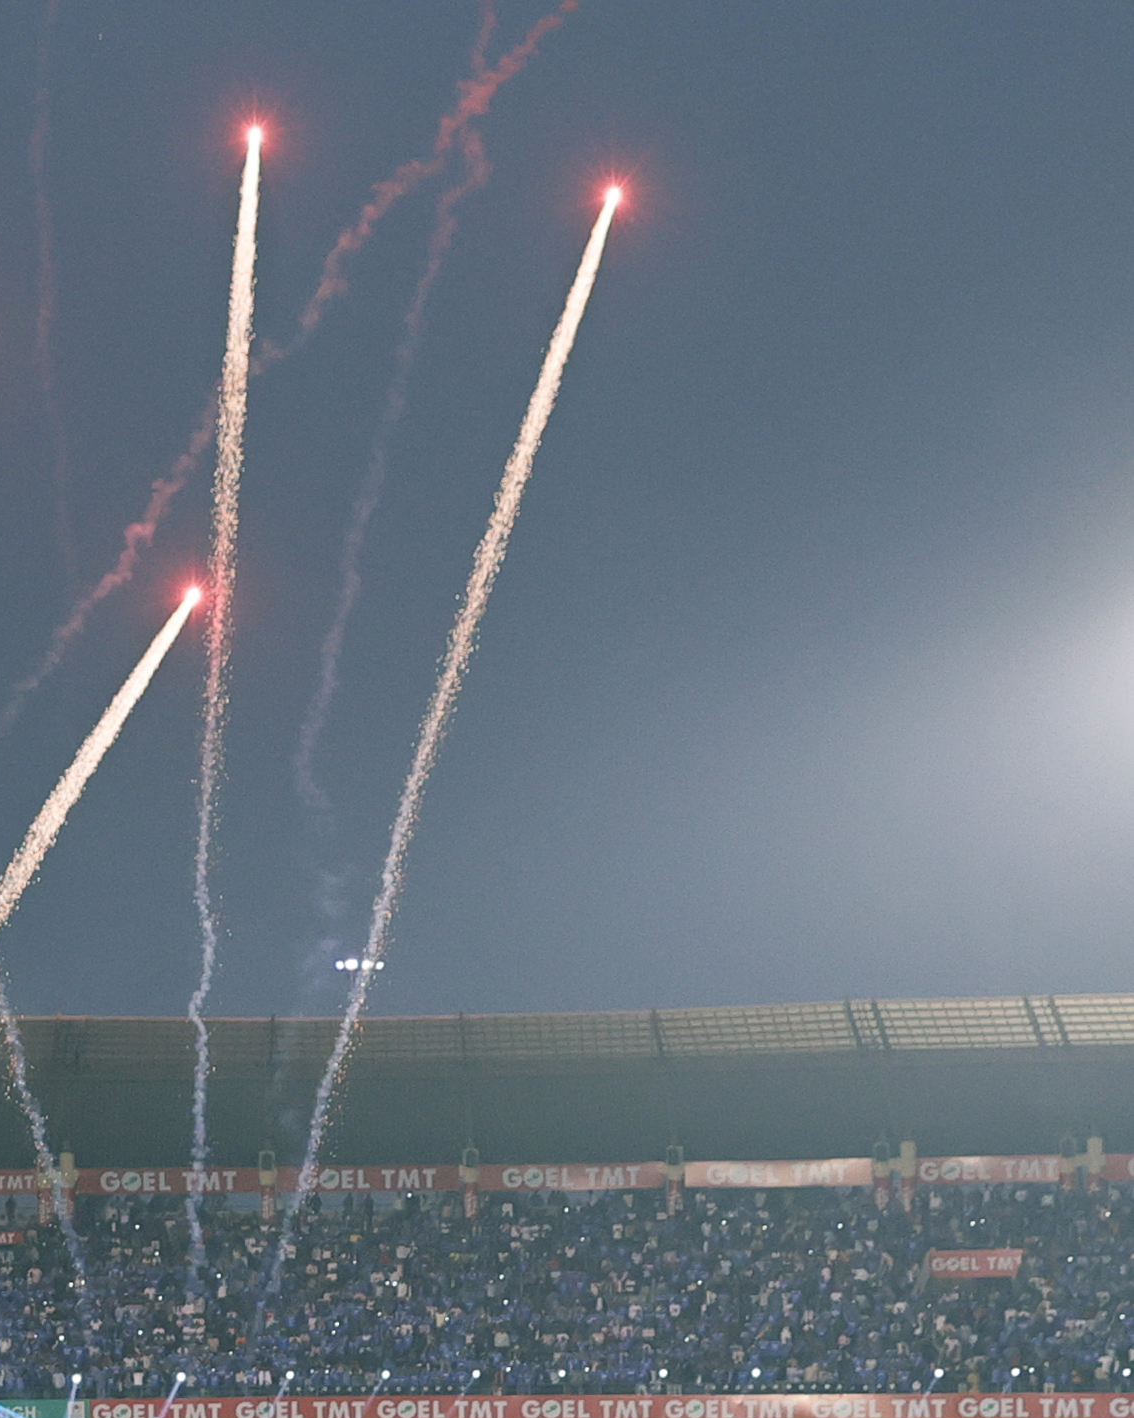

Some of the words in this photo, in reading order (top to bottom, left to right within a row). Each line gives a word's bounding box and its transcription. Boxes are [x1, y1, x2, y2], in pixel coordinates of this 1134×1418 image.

[381, 1168, 437, 1189] TMT
[501, 1167, 574, 1188] GOEL
[584, 1165, 641, 1186] TMT
[706, 1164, 779, 1185] GOEL
[791, 1162, 851, 1183] TMT
[919, 1162, 991, 1180] GOEL
[1002, 1160, 1059, 1178] TMT
[99, 1171, 172, 1191] GOEL
[931, 1256, 980, 1271] GOEL
[811, 1398, 882, 1418] GOEL
[891, 1398, 947, 1418] TMT
[957, 1397, 1030, 1418] GOEL
[1039, 1398, 1095, 1418] TMT
